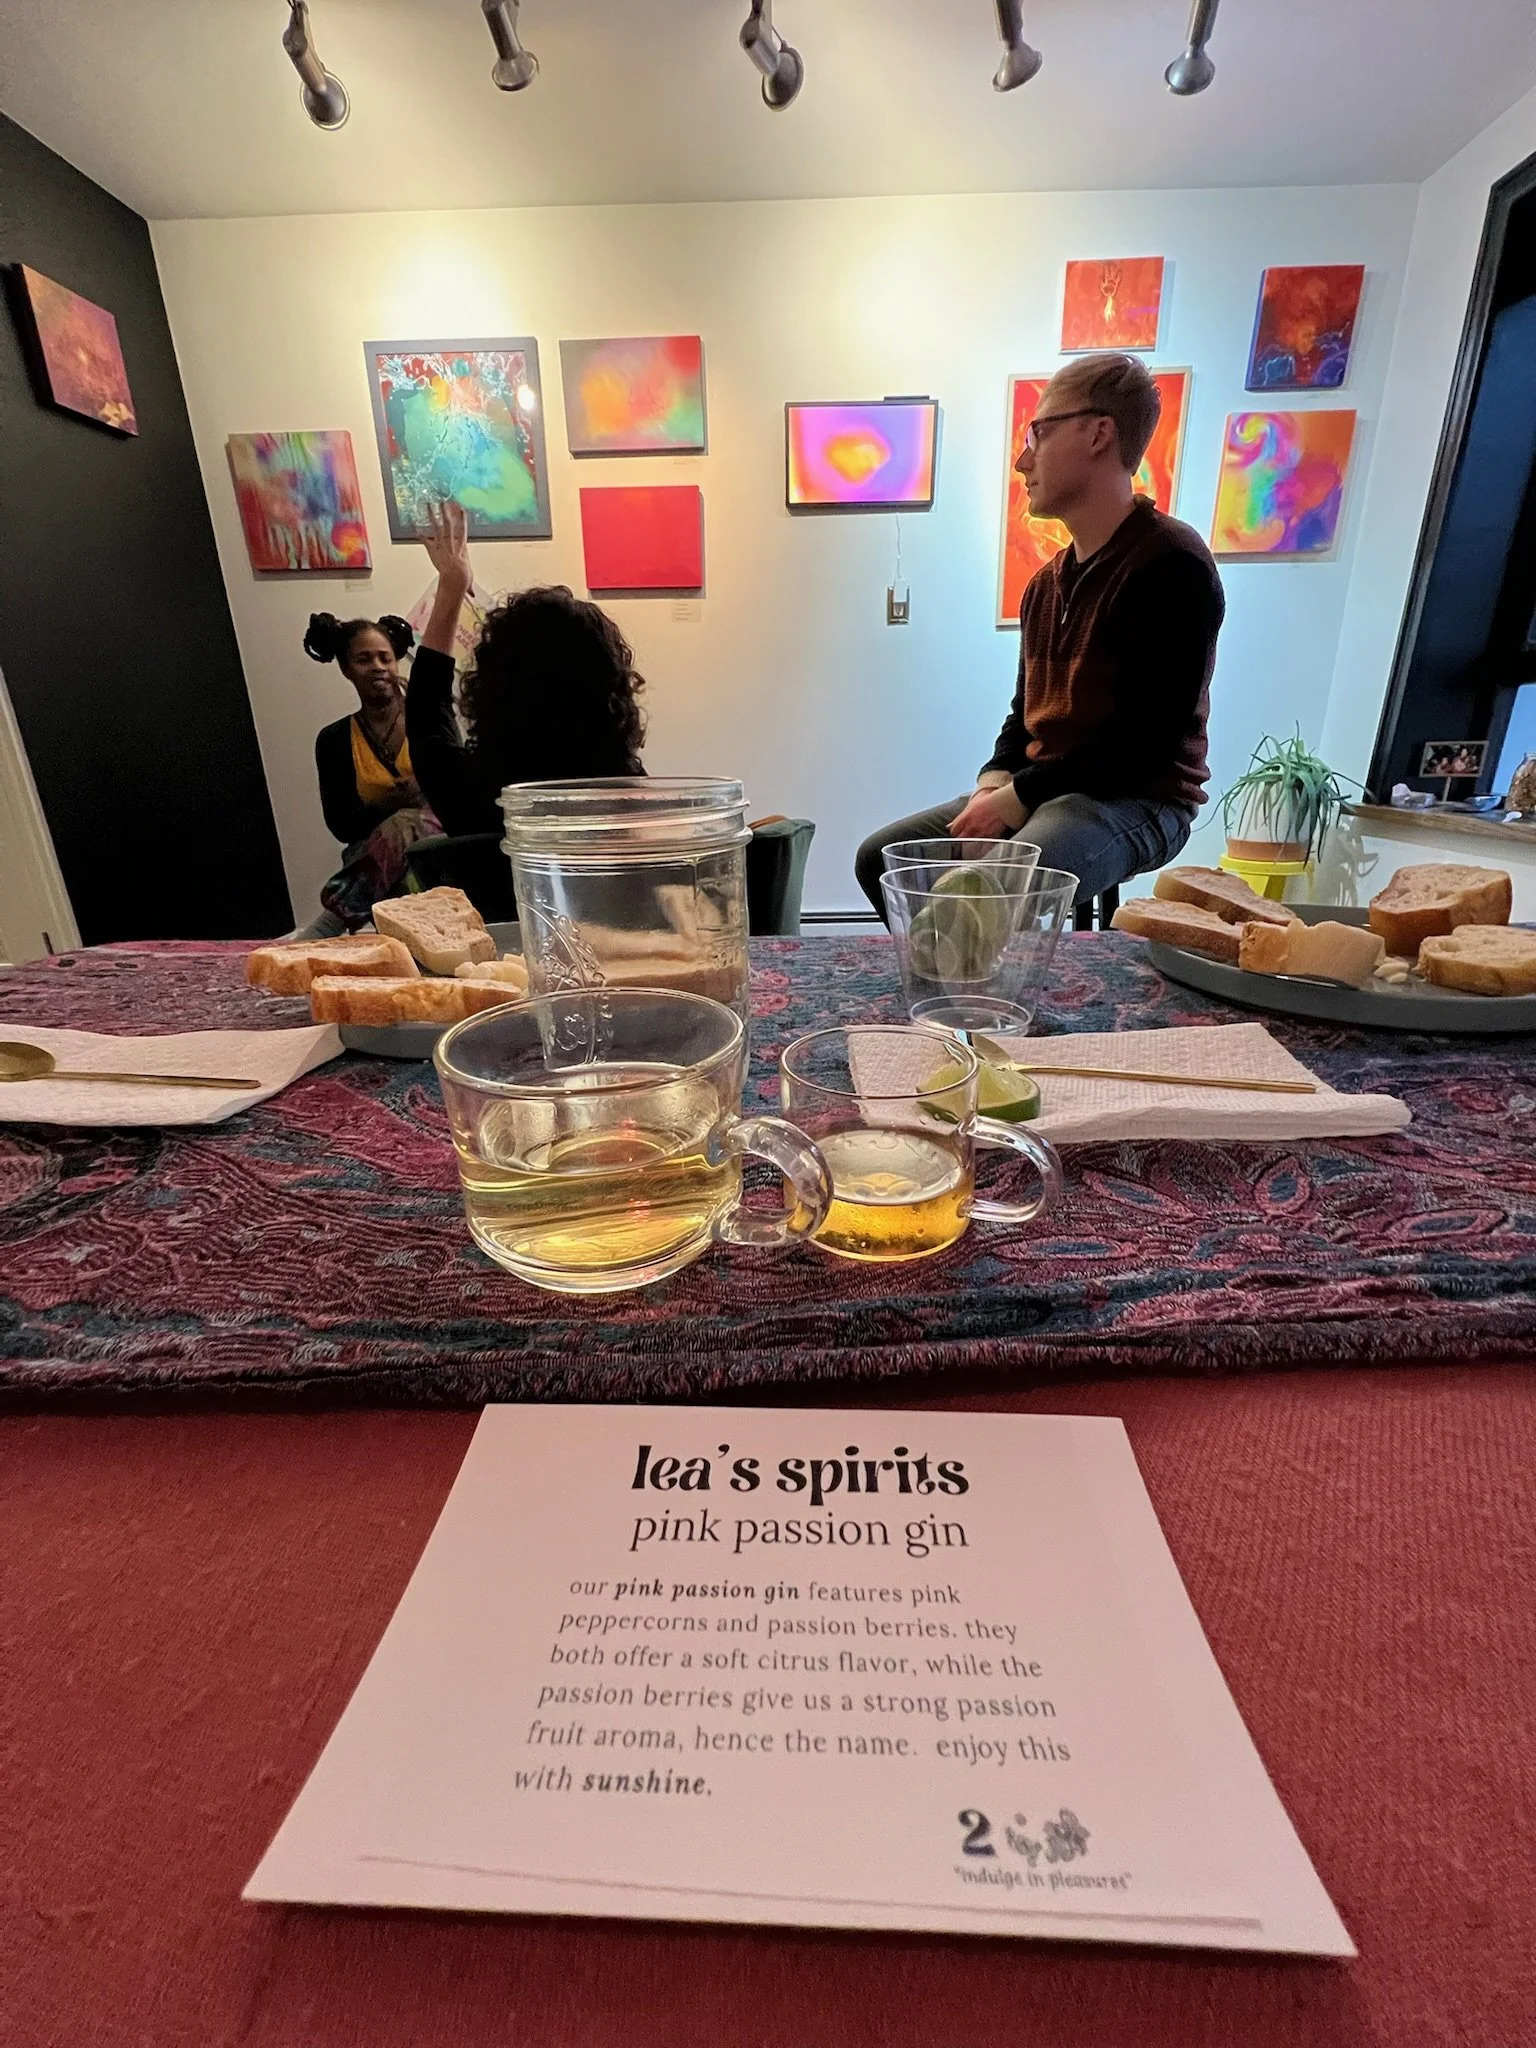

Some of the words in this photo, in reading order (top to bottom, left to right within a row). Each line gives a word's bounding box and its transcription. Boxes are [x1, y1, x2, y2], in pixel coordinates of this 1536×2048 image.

[631, 1444, 761, 1494] lea's
[775, 1445, 970, 1508] spirits
[629, 1508, 722, 1553] pink
[733, 1512, 891, 1555] passion
[904, 1511, 970, 1559] gin
[569, 1579, 609, 1597] our
[613, 1576, 664, 1601] pink
[671, 1579, 756, 1603] passion
[763, 1580, 801, 1606] gin
[808, 1581, 903, 1606] features
[910, 1584, 961, 1609] pink
[557, 1614, 709, 1637] peppercorns
[716, 1613, 759, 1634] and
[767, 1615, 856, 1640] passion
[864, 1616, 957, 1640] berries.
[964, 1618, 1018, 1646] they
[549, 1643, 606, 1667] both
[613, 1644, 674, 1670] offer
[680, 1652, 693, 1670] a
[702, 1646, 750, 1671] soft
[757, 1649, 830, 1673] citrus
[838, 1650, 918, 1678] flavor,
[925, 1653, 993, 1678] while
[1000, 1655, 1043, 1679] the
[537, 1683, 634, 1710] passion
[643, 1683, 733, 1710] berries
[742, 1686, 794, 1717] give
[803, 1693, 832, 1713] us
[841, 1695, 853, 1713] a
[863, 1693, 950, 1722] strong
[957, 1694, 1057, 1723] passion
[526, 1719, 585, 1748] fruit
[593, 1729, 684, 1754] aroma,
[694, 1724, 774, 1753] hence
[784, 1727, 827, 1755] the
[837, 1734, 918, 1758] name.
[936, 1733, 1009, 1768] enjoy
[1018, 1735, 1071, 1764] this
[514, 1764, 573, 1793] with
[582, 1767, 712, 1798] sunshine.
[957, 1808, 999, 1858] 2
[1027, 1871, 1045, 1888] in
